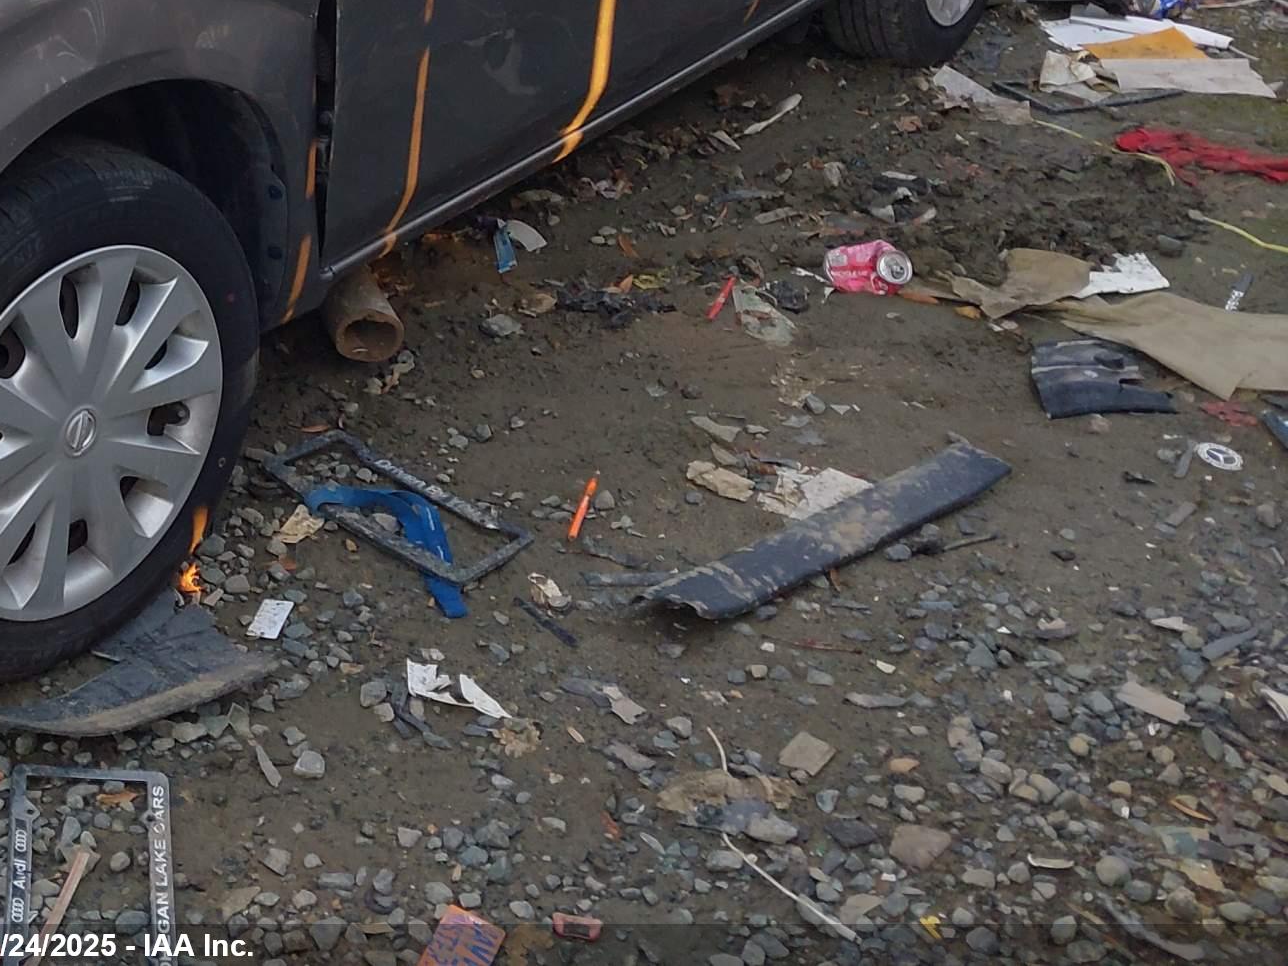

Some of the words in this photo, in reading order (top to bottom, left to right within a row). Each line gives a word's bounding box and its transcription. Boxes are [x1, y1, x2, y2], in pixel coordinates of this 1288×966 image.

[152, 785, 166, 834] CARS
[13, 859, 28, 890] Audi
[153, 839, 169, 886] LAKE
